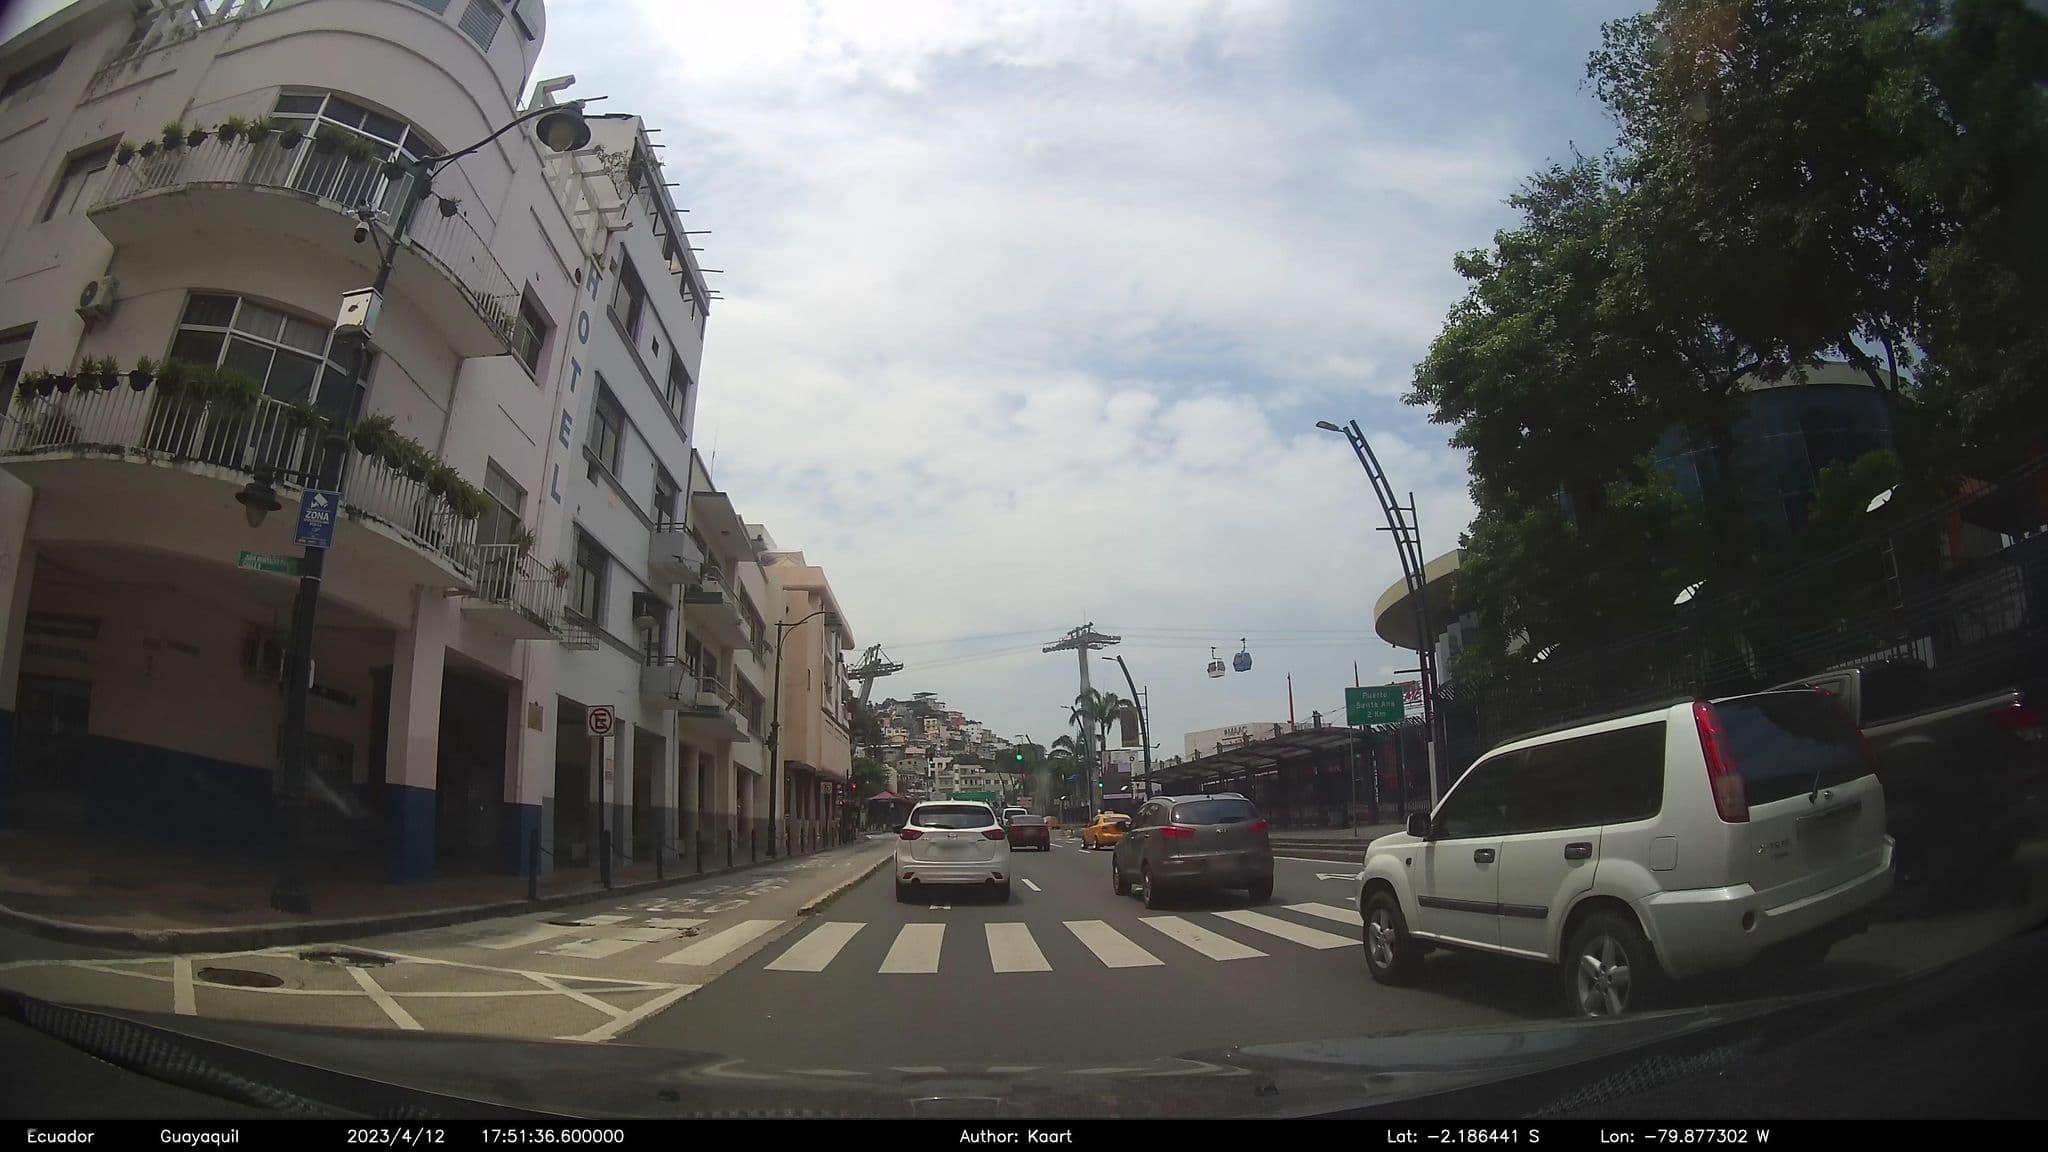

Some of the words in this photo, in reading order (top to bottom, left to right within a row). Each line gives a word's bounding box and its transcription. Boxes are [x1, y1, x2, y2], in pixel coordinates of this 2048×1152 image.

[551, 267, 599, 504] HOTEL
[304, 510, 329, 521] ZONA
[1361, 691, 1388, 699] Puerto
